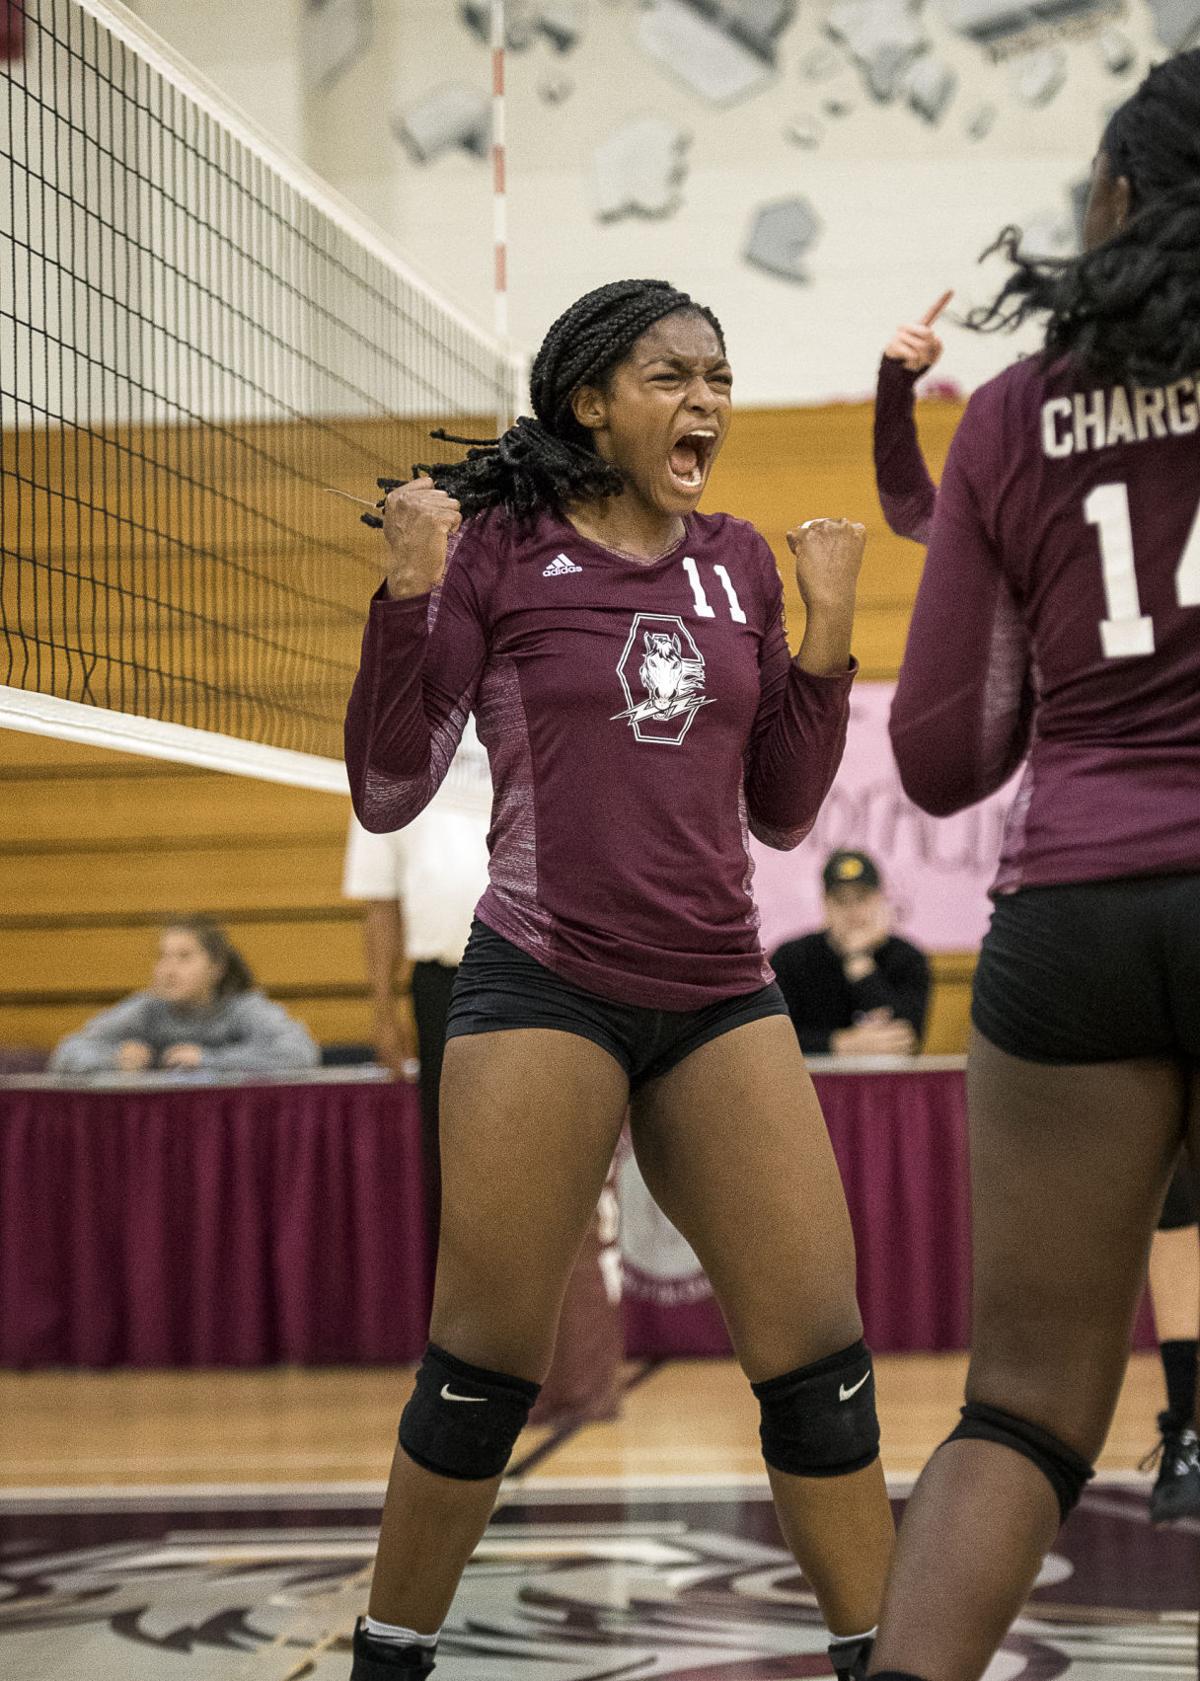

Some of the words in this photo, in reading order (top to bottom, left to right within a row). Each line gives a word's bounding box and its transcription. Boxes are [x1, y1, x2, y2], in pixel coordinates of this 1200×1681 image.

[1042, 377, 1200, 458] CHARG
[542, 565, 582, 577] adidas
[682, 557, 747, 624] 11
